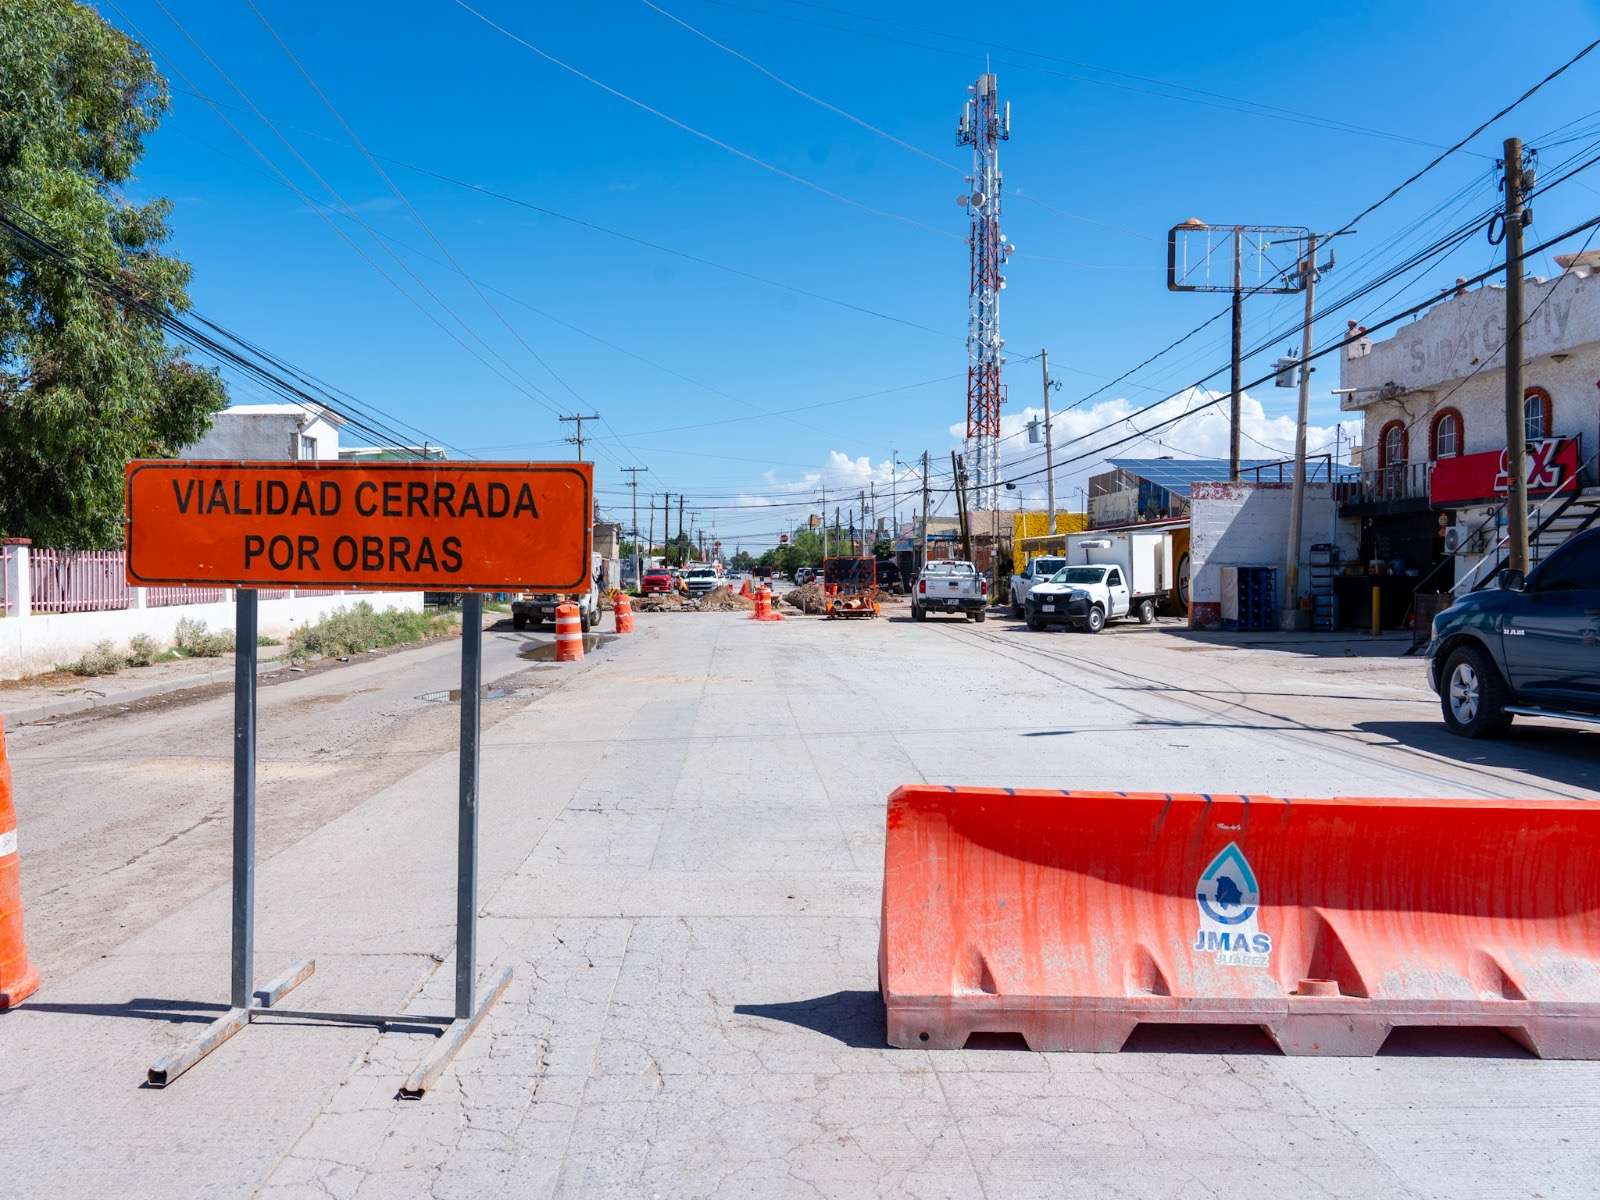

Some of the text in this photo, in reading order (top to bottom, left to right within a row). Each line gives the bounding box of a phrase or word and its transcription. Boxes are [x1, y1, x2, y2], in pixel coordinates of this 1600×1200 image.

[172, 479, 539, 519] VIALIDAD CERRADA
[244, 534, 463, 573] POR OBRAS
[1195, 931, 1270, 953] JMAS
